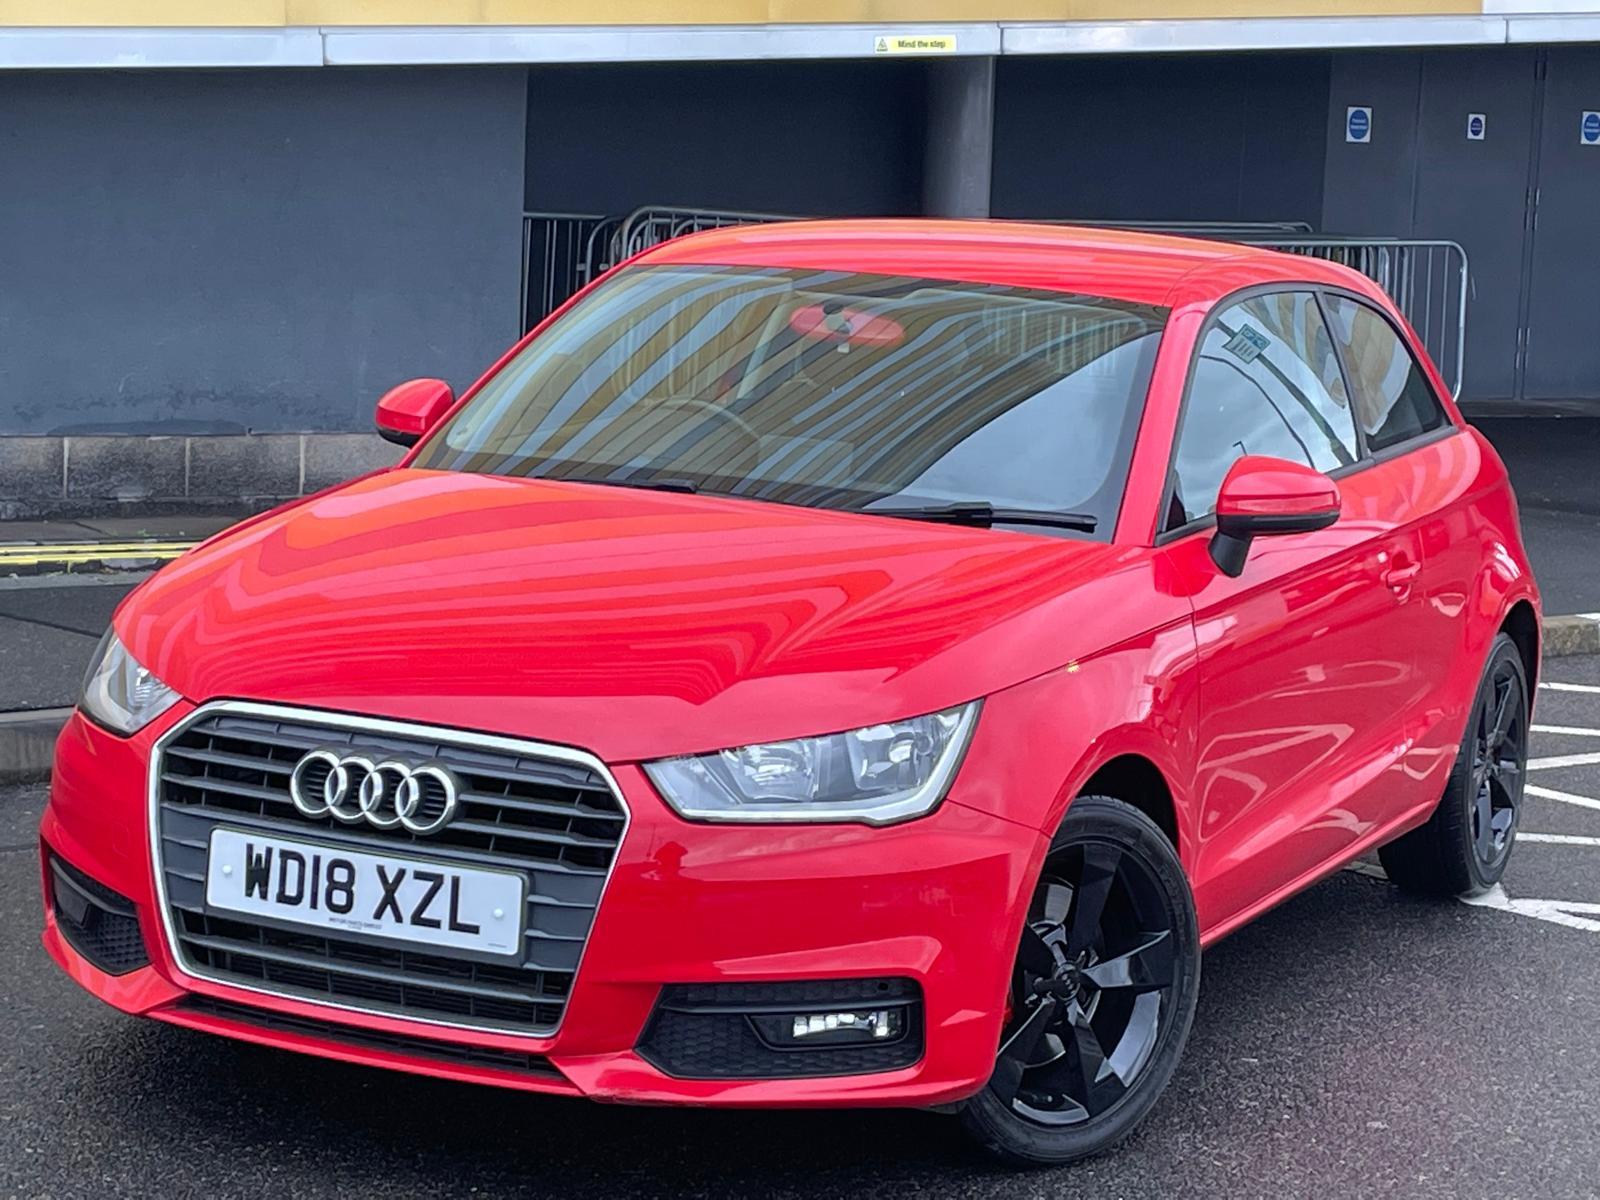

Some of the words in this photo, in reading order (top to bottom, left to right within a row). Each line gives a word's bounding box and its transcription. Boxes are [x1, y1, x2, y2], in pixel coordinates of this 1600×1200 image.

[897, 40, 916, 48] Mind
[917, 40, 929, 48] the
[930, 40, 946, 49] step
[245, 843, 355, 915] WD18
[373, 864, 480, 935] XZL
